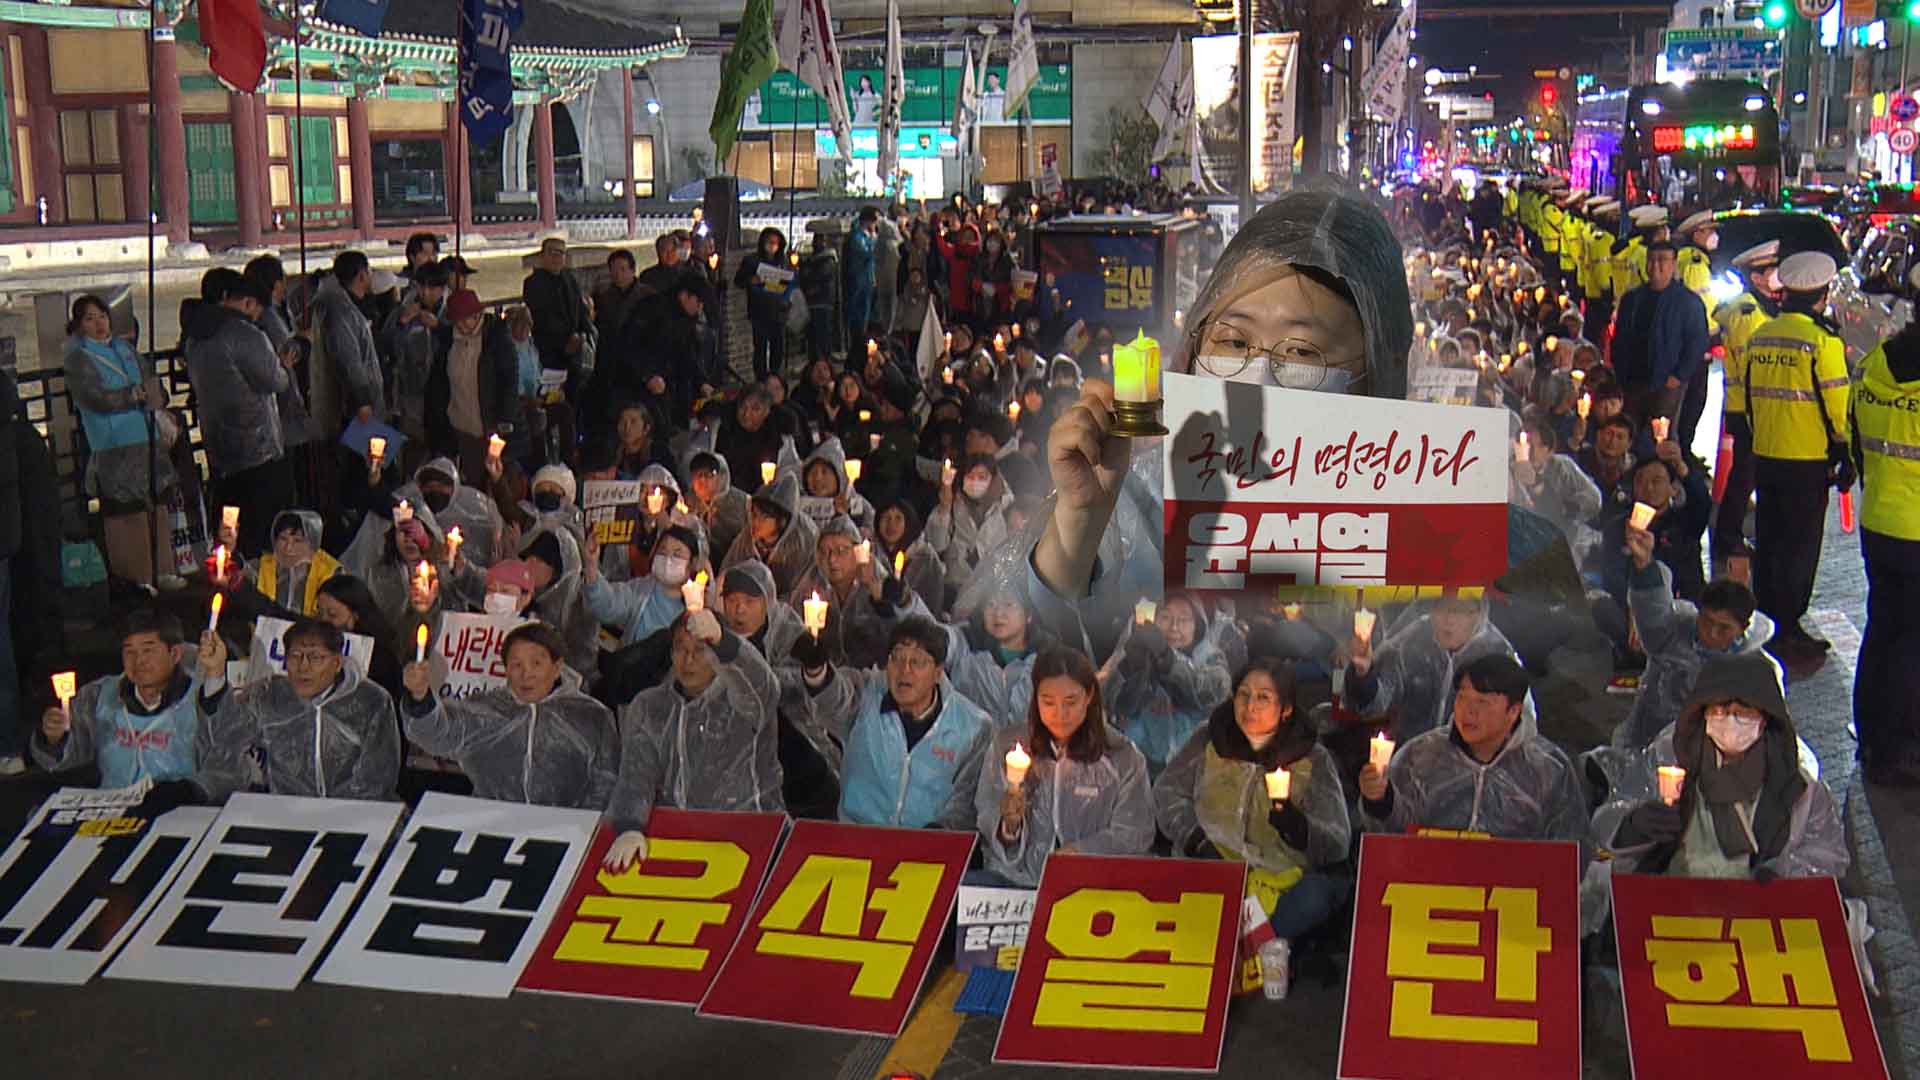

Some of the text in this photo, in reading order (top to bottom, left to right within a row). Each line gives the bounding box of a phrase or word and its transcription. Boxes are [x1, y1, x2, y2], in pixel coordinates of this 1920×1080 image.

[1894, 135, 1912, 146] 40
[1750, 352, 1798, 367] POLICE
[1857, 390, 1920, 413] POCE
[1188, 429, 1479, 492] 국민의 명령이다
[1185, 512, 1389, 590] 윤석열
[156, 826, 372, 954] 란
[364, 826, 570, 962] 범
[553, 838, 750, 970] 윤
[756, 855, 946, 1000] 석
[1033, 888, 1224, 1033] 열
[1381, 883, 1552, 1045] 탄
[1645, 915, 1852, 1062] 핵
